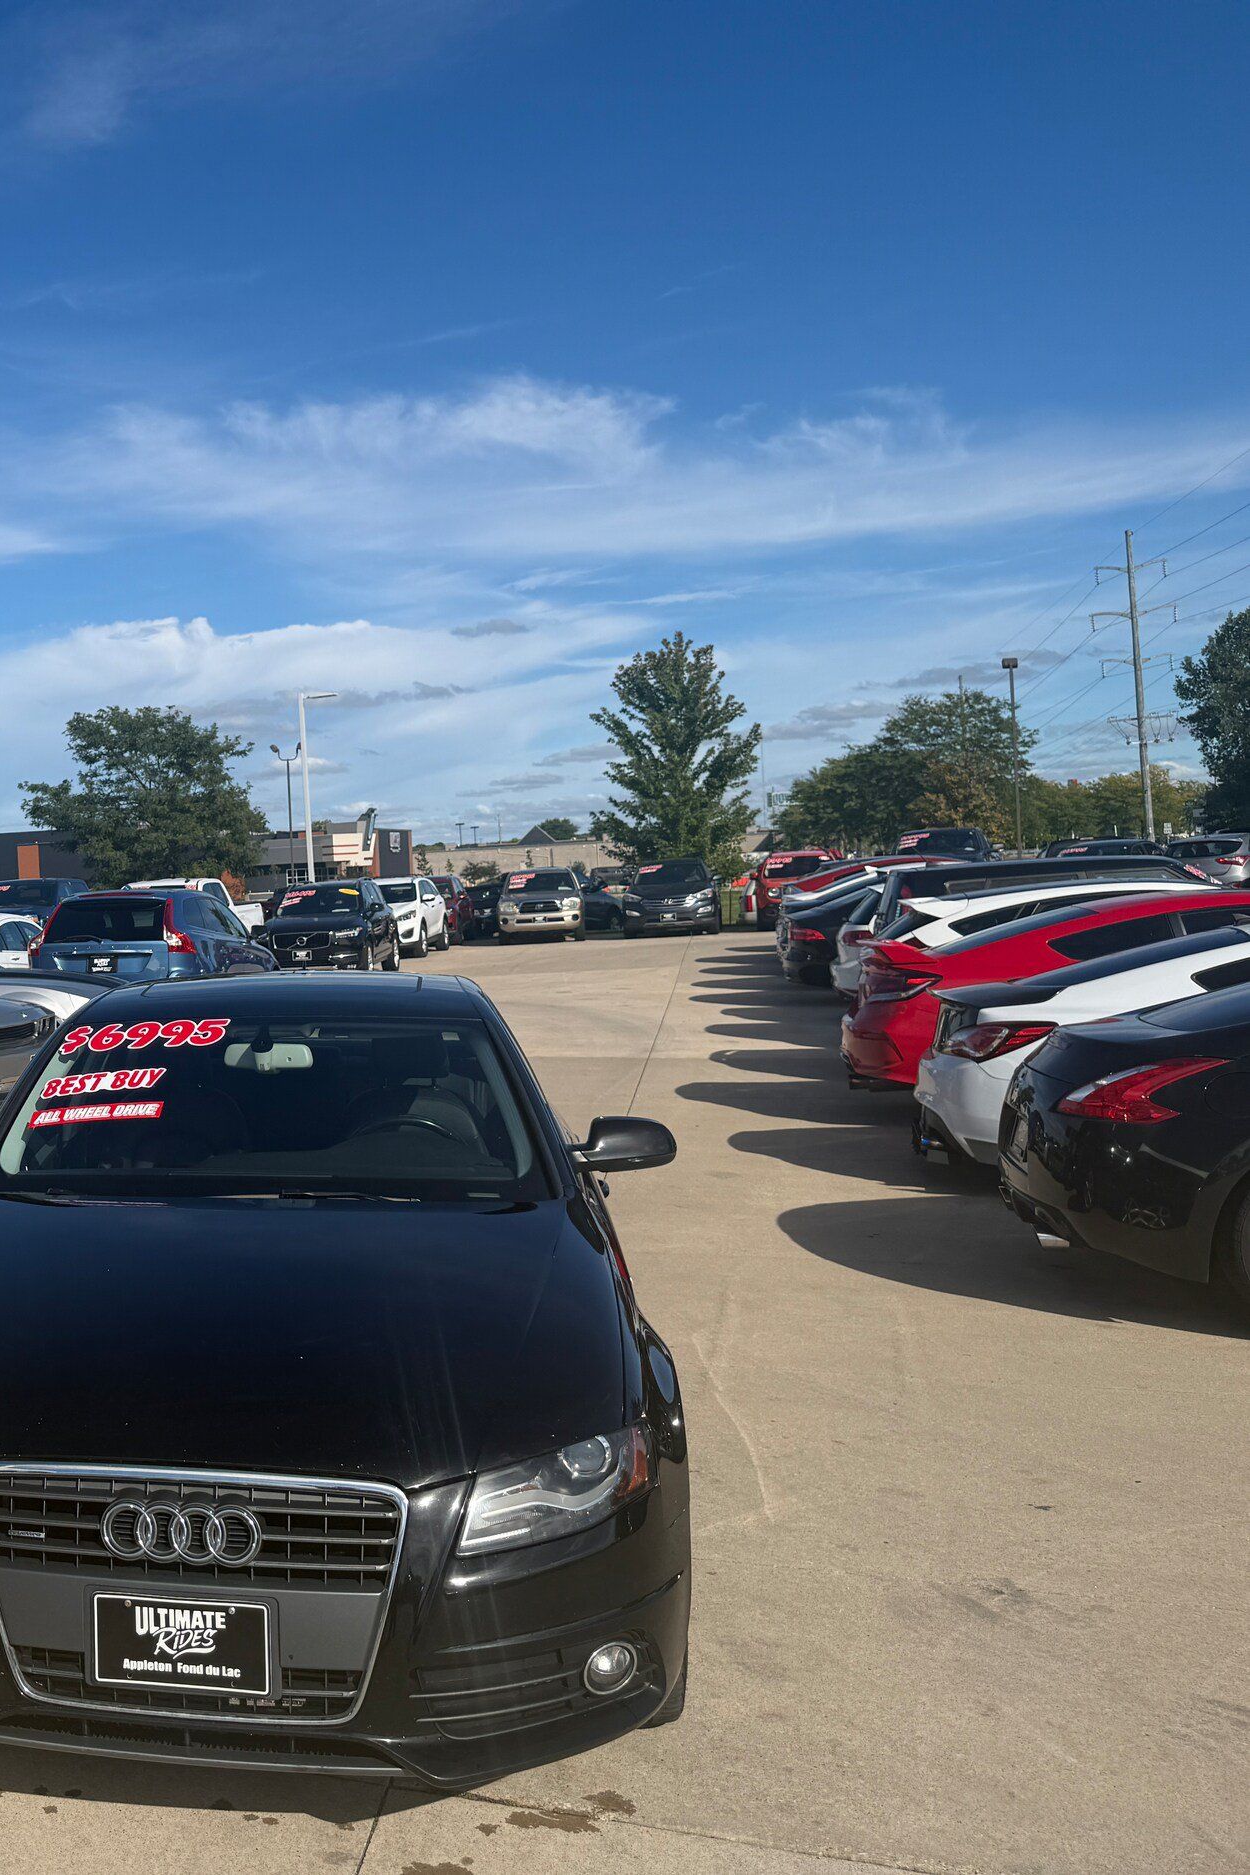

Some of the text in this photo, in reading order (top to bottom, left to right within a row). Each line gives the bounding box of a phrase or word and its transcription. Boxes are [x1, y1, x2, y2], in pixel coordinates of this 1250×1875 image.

[60, 1018, 231, 1055] $6995
[41, 1068, 167, 1099] BEST BUY
[34, 1103, 159, 1124] ALL WHEEL DRIVE
[135, 1606, 226, 1635] ULTIMATE
[123, 1658, 241, 1678] Appleton Fond du Lac
